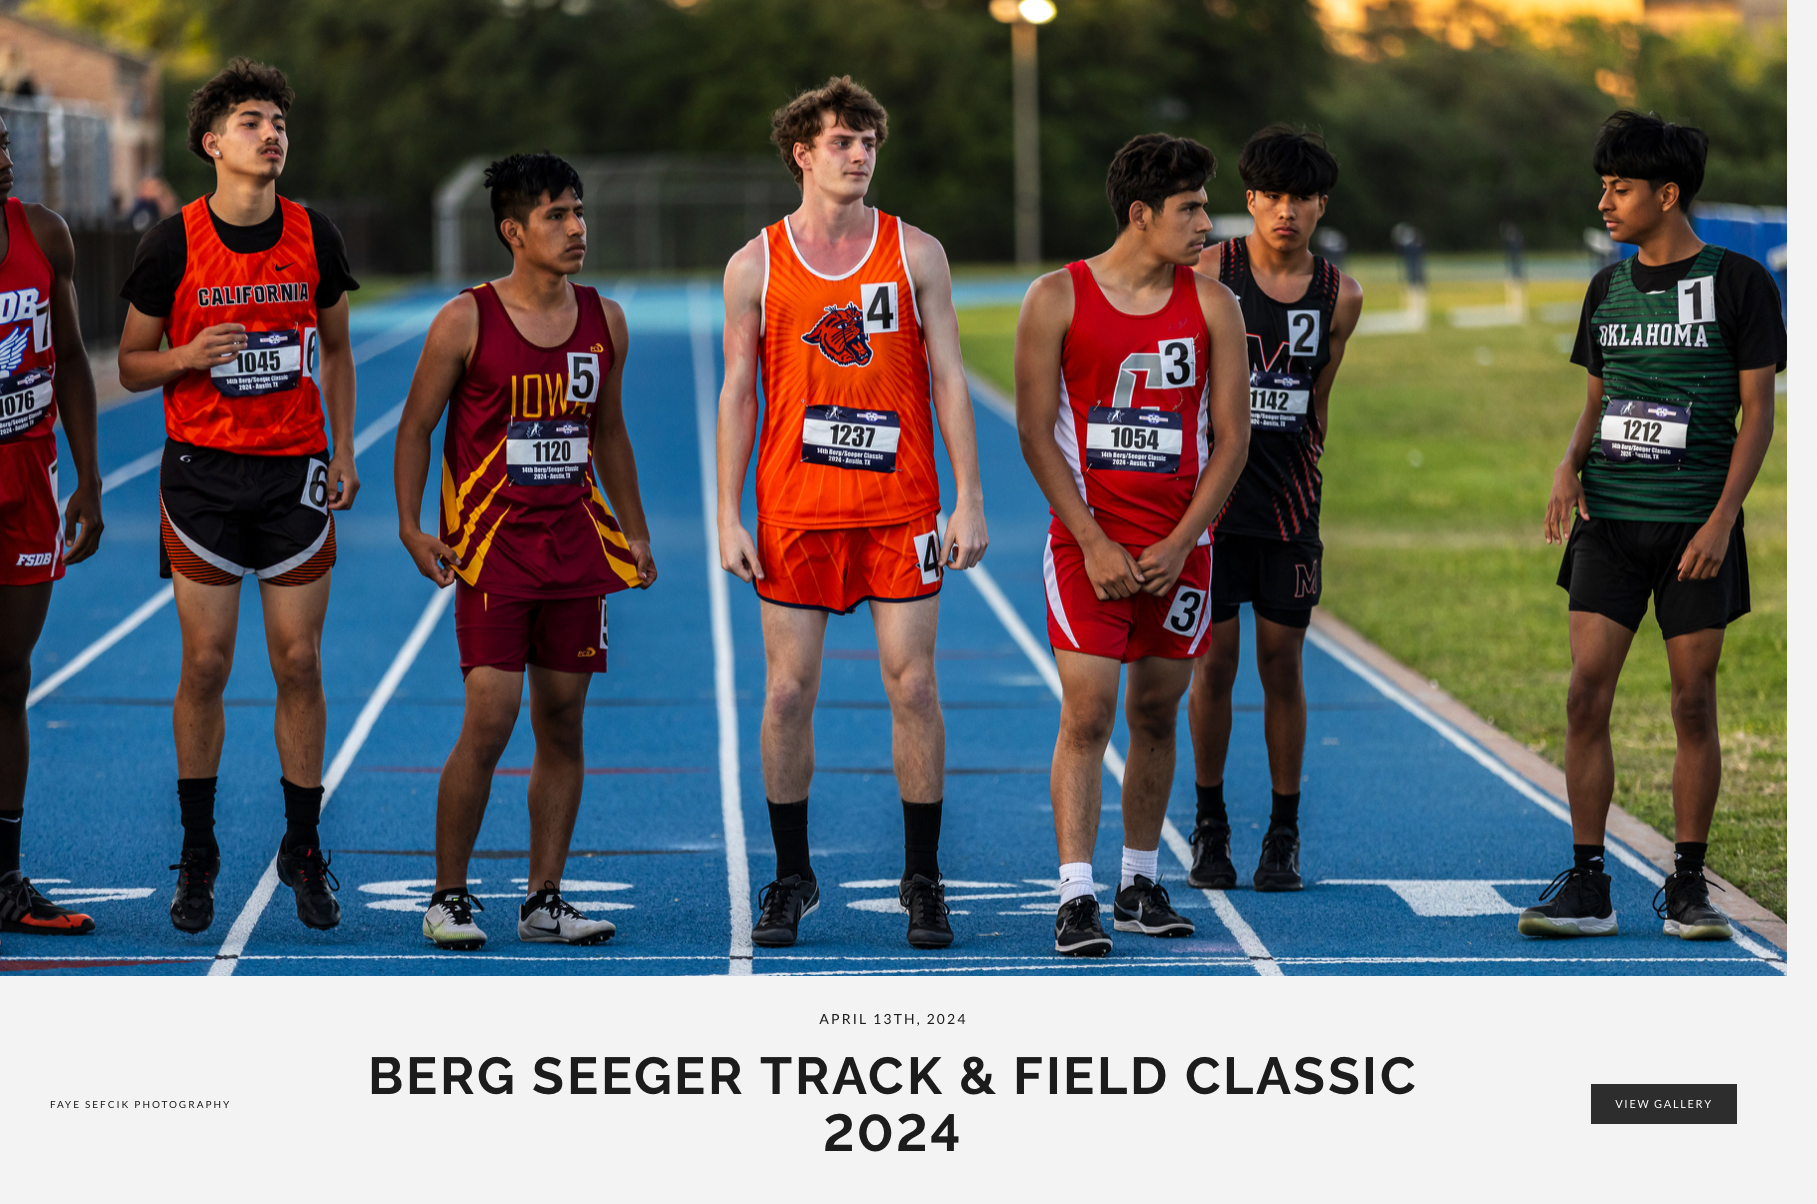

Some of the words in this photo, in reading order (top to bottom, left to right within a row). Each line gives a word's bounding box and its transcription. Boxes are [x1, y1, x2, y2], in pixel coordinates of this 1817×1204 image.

[197, 282, 309, 308] CALIFORNIA
[1684, 281, 1703, 320] 1
[866, 286, 894, 330] 4
[36, 304, 50, 348] 7
[1292, 313, 1315, 353] 2
[1599, 323, 1709, 347] OKLAHOMA
[237, 350, 281, 373] 1045
[1164, 342, 1190, 385] 3
[572, 356, 594, 399] 5
[1250, 389, 1290, 411] 1142
[830, 424, 876, 448] 1237
[1110, 427, 1159, 450] 1054
[1623, 419, 1662, 443] 1212
[533, 440, 571, 462] 1120
[817, 447, 829, 455] 14th
[863, 452, 884, 460] Classic
[828, 455, 842, 463] 2024
[1147, 454, 1167, 462] Classic
[1651, 447, 1672, 455] Classic
[309, 464, 328, 508] 6
[15, 552, 53, 567] FSDB
[924, 534, 940, 578] 4
[1294, 559, 1318, 598] M
[1170, 591, 1201, 632] 3
